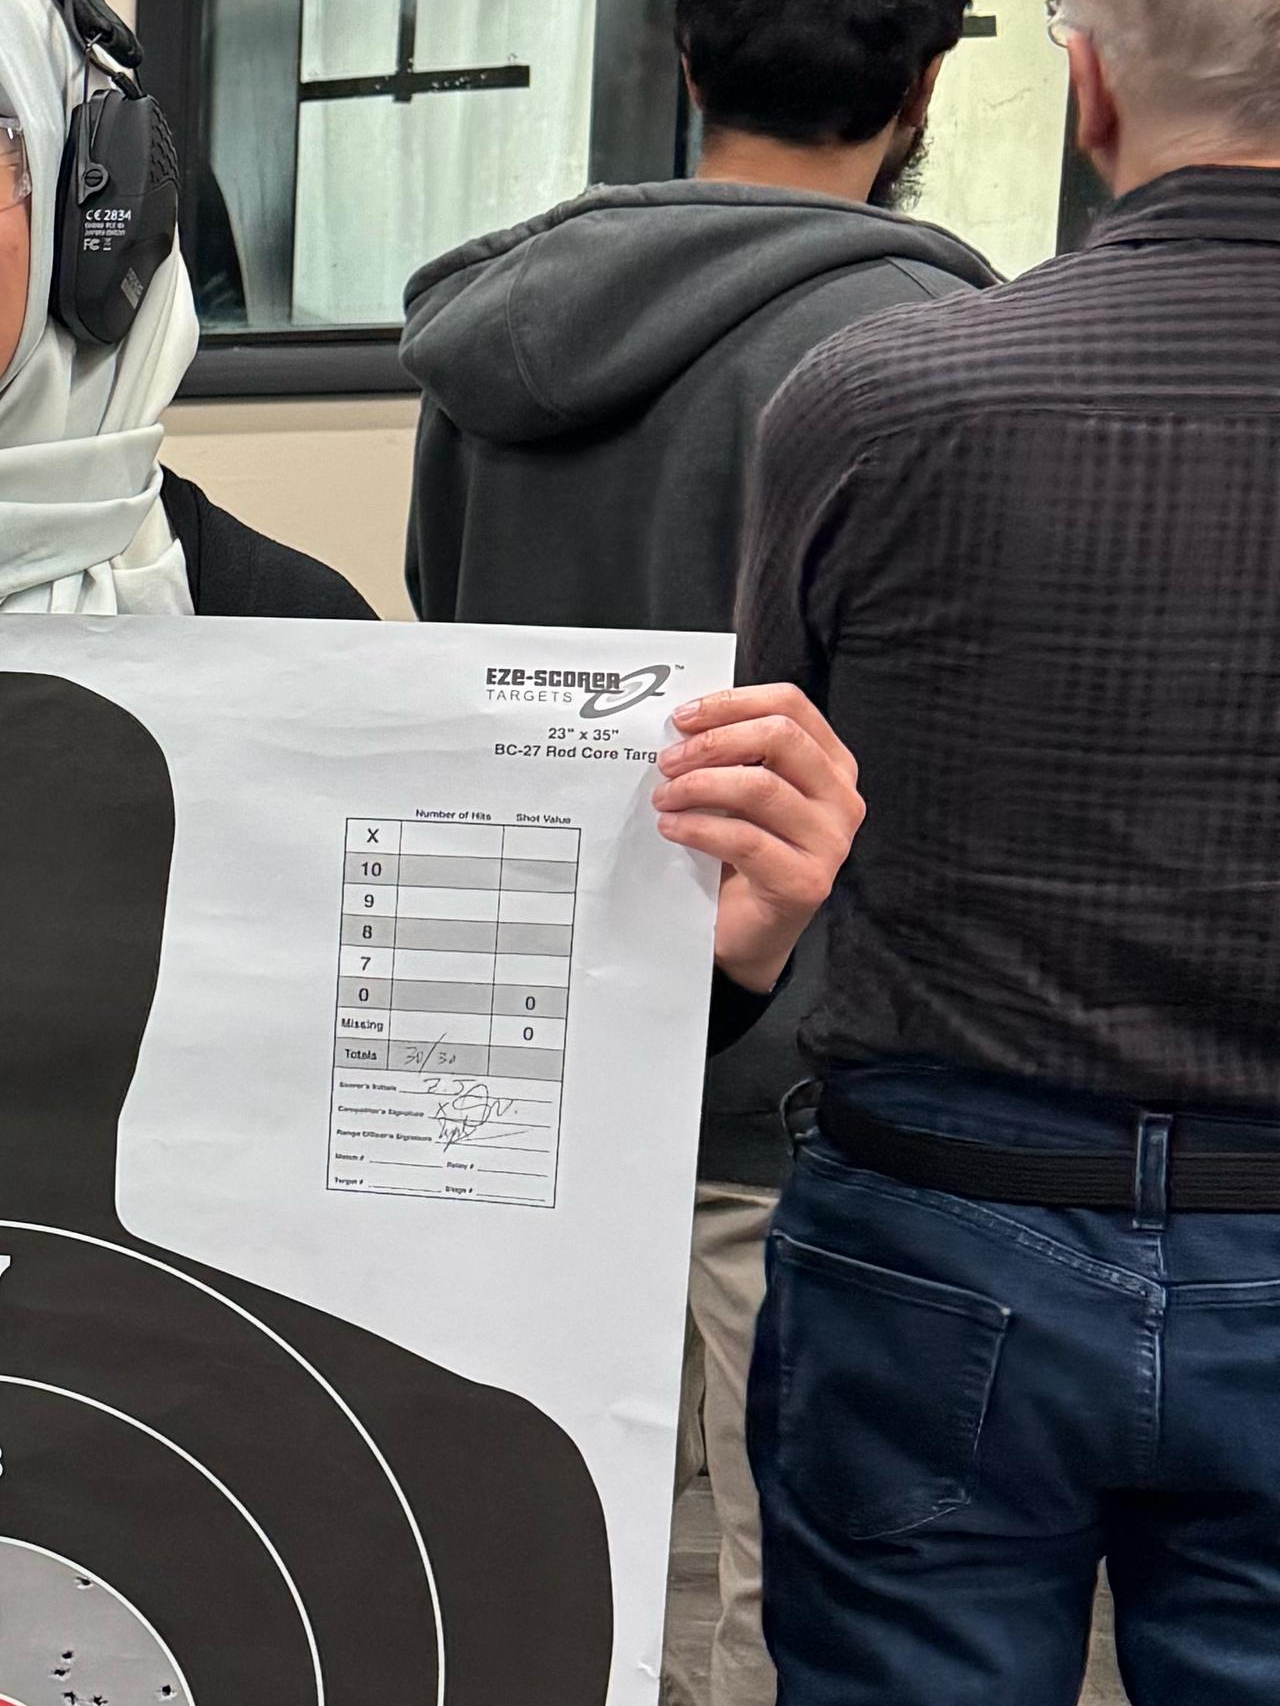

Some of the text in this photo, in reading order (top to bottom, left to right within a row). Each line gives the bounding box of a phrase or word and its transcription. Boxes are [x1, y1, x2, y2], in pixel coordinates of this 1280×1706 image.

[103, 209, 132, 221] 2834
[486, 689, 573, 703] TARGETS
[494, 743, 541, 757] BC-27
[581, 747, 618, 760] Core
[415, 808, 456, 820] Number
[458, 811, 469, 819] of
[366, 828, 379, 843] X
[361, 862, 382, 877] 10
[364, 894, 375, 908] 9
[362, 925, 373, 939] 8
[360, 956, 371, 971] 7
[358, 988, 369, 1002] 0
[525, 996, 536, 1010] 0
[341, 1018, 384, 1033] Missing
[523, 1027, 534, 1041] 0
[344, 1048, 378, 1060] Totals
